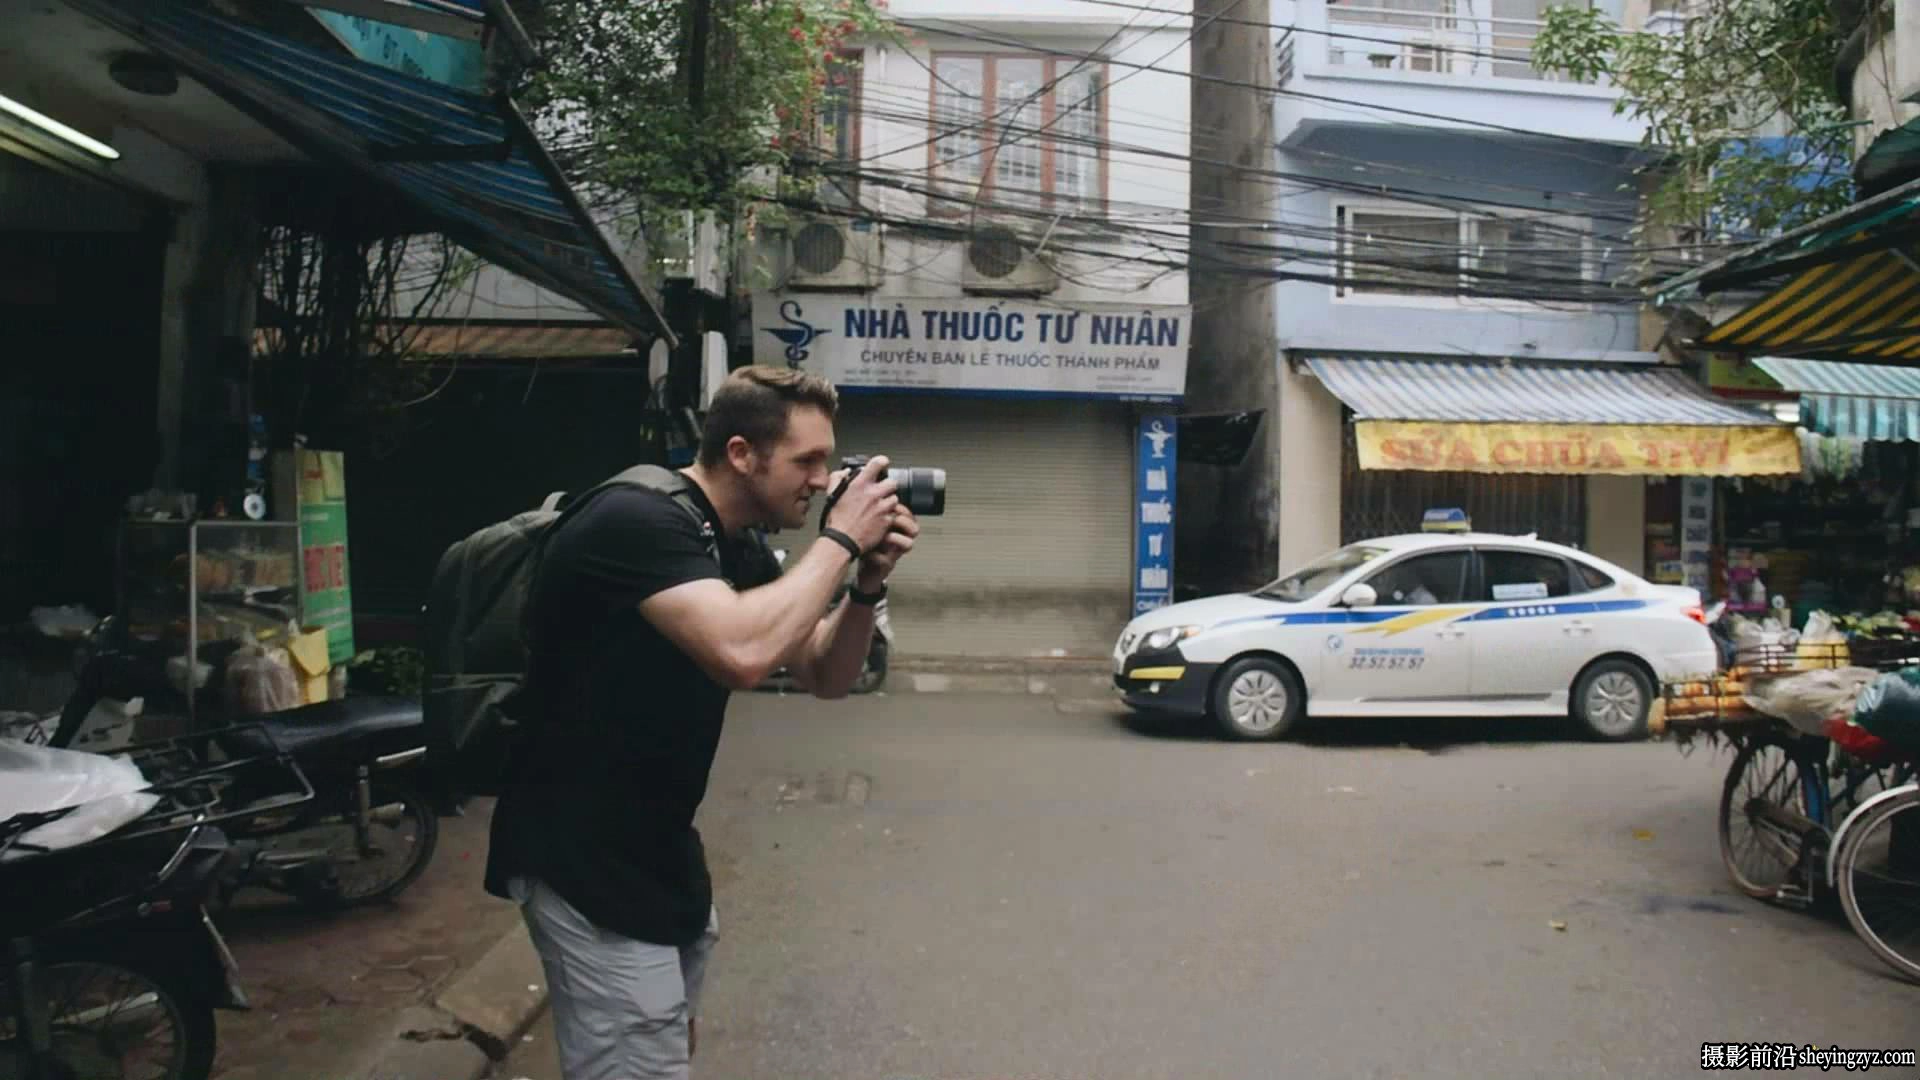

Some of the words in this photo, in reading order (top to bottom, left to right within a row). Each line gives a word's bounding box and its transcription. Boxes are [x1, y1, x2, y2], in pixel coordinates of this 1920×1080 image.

[845, 303, 911, 339] NHÀ
[922, 301, 1025, 342] THUỐC
[1036, 311, 1080, 344] TƯ
[1090, 311, 1180, 346] NHÂN
